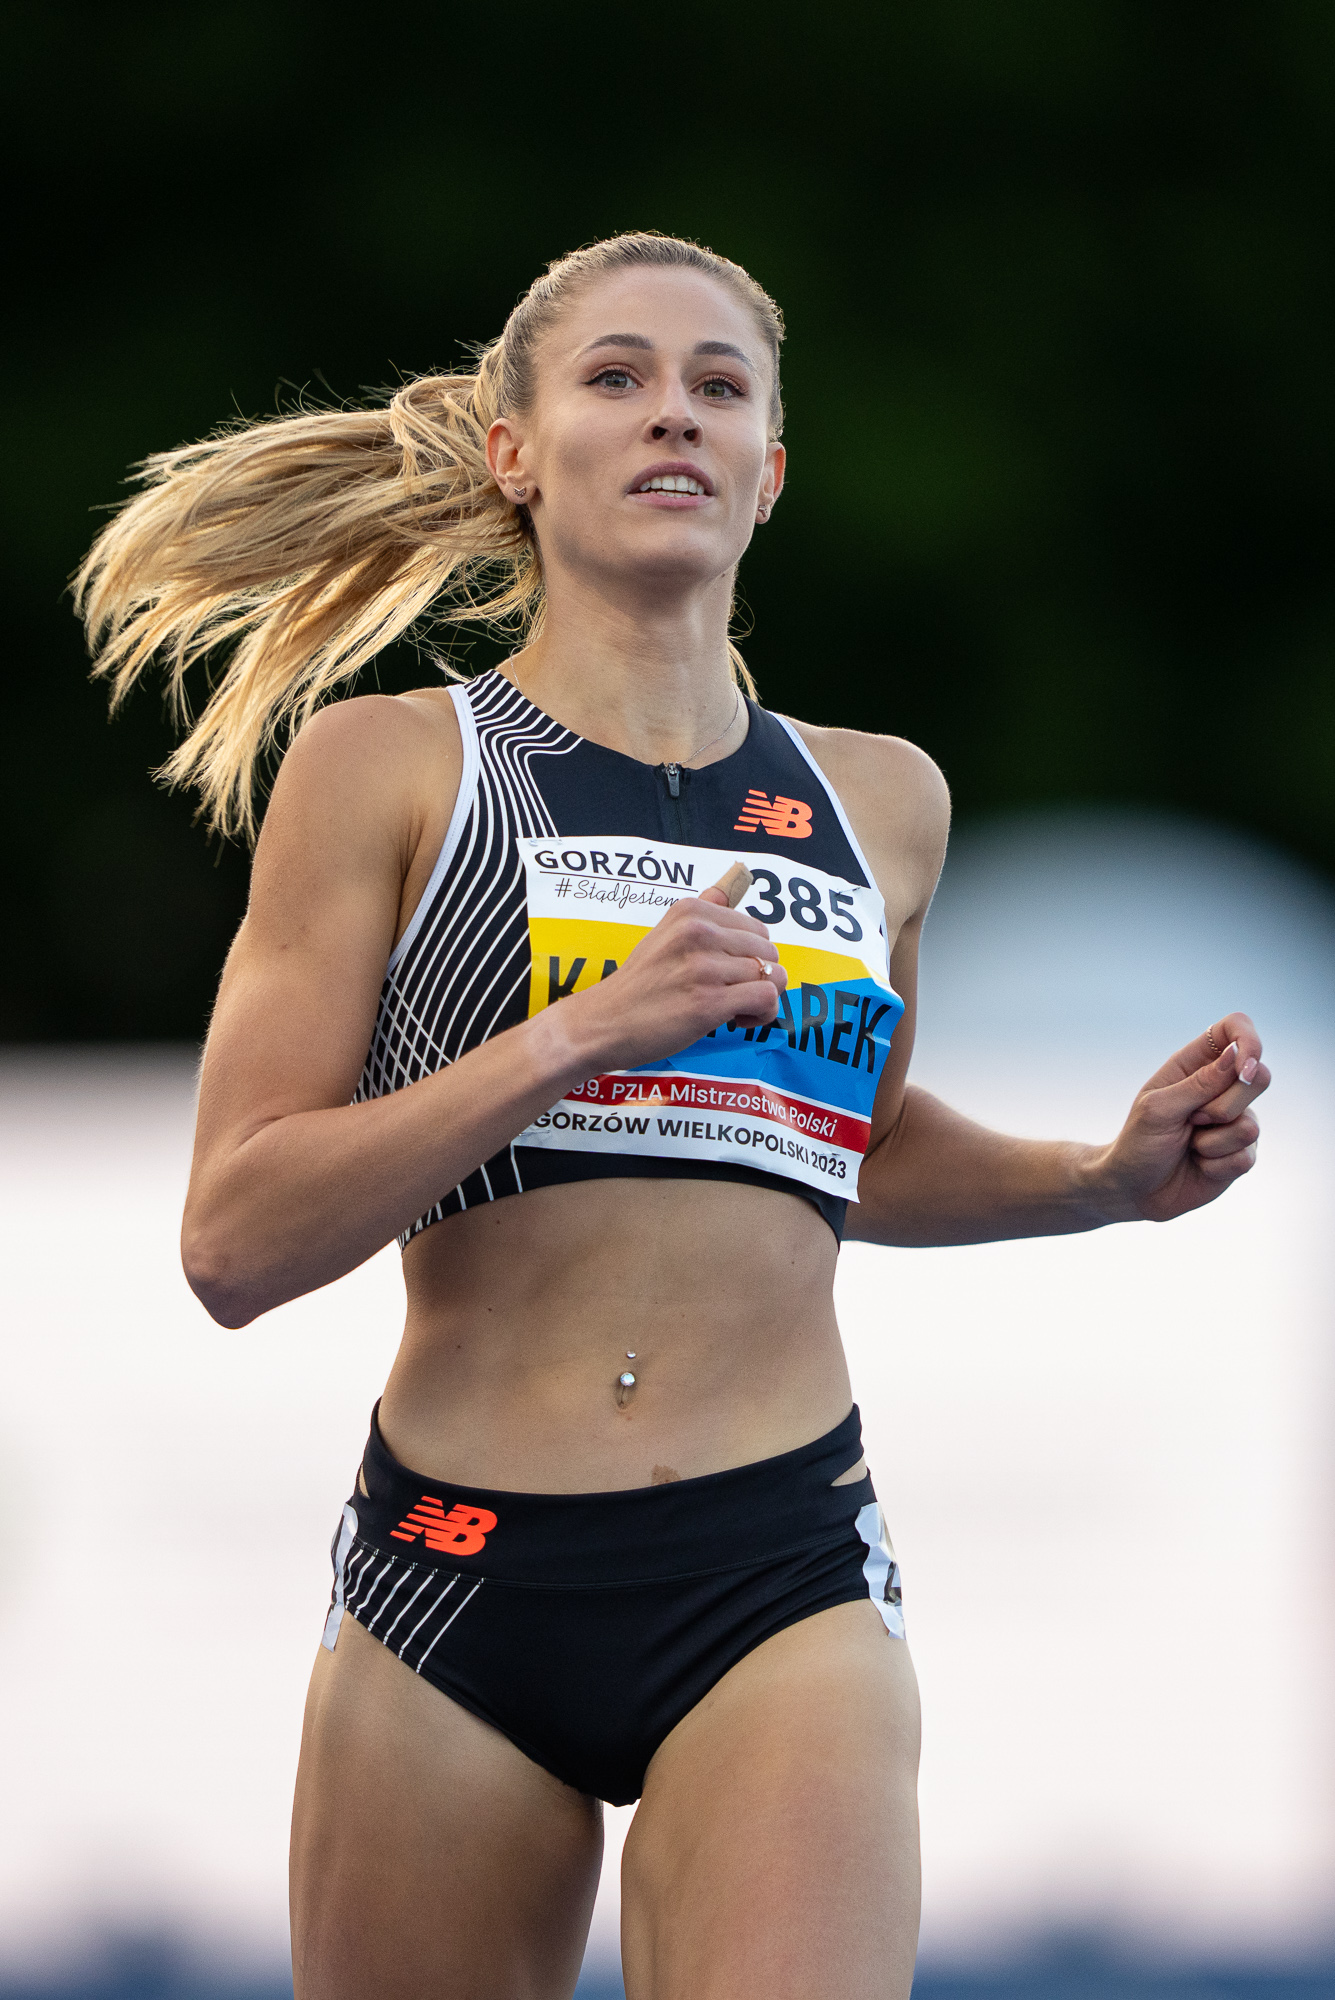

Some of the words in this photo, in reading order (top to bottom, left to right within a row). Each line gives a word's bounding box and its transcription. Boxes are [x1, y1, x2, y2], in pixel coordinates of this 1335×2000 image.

[733, 789, 813, 839] NB
[534, 850, 695, 887] GORZÓW
[745, 868, 863, 942] 385
[611, 1083, 662, 1101] PZLA
[670, 1083, 787, 1120] Mistrzostwa
[789, 1106, 838, 1139] Polski
[533, 1111, 651, 1135] GORZÓW
[657, 1118, 809, 1165] WIELKOPOLSKI
[811, 1151, 847, 1179] 2023
[389, 1495, 498, 1556] NB
